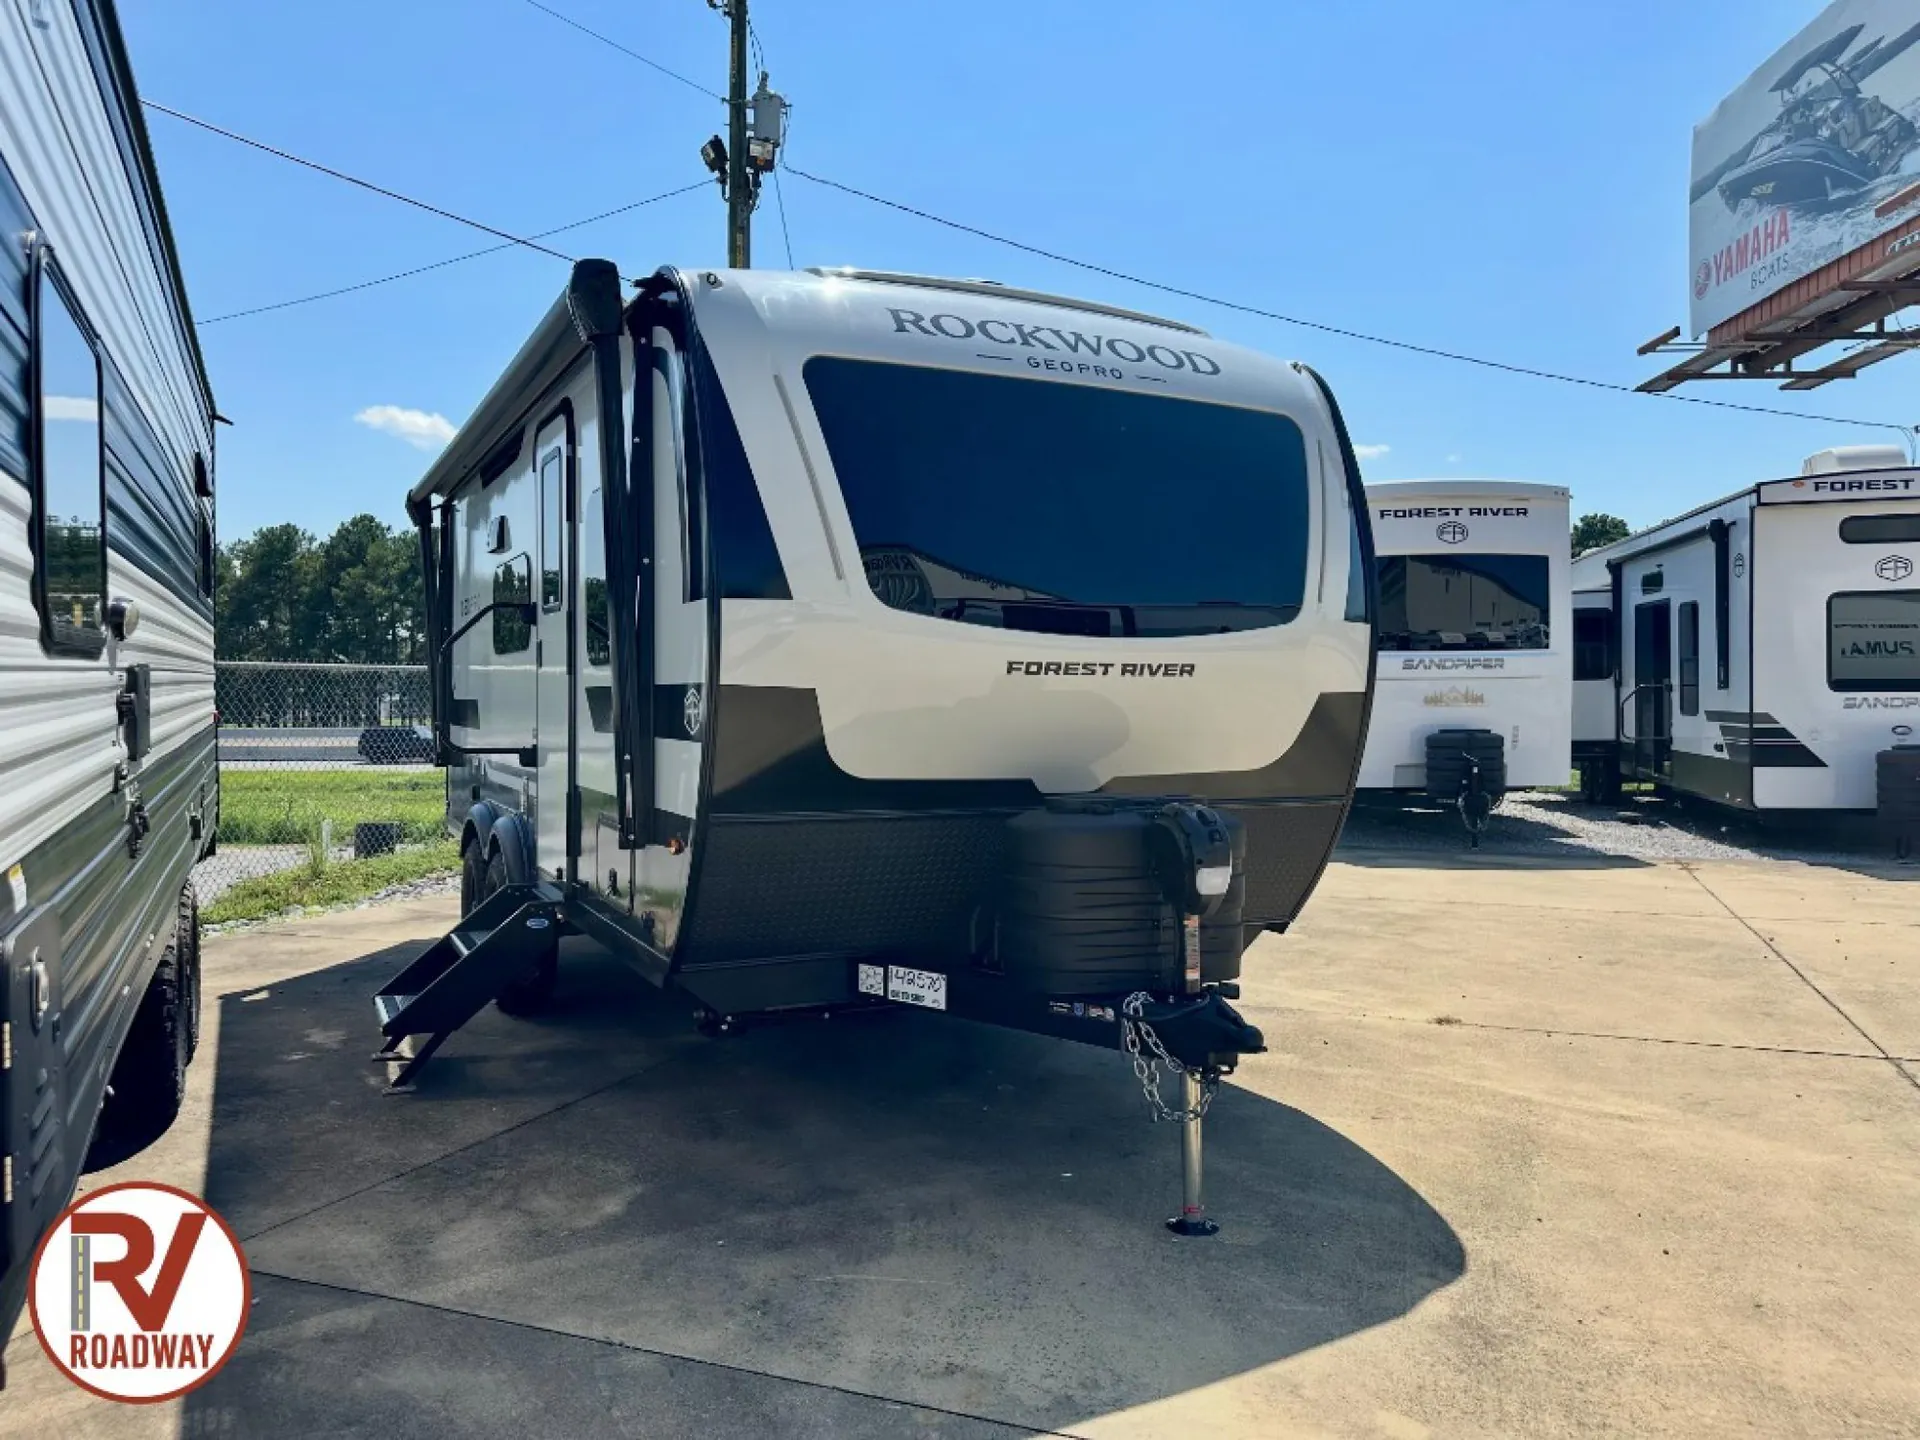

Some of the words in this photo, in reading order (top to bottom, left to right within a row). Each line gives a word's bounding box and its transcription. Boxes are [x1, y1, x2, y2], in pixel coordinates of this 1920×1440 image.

[1713, 208, 1790, 287] YAMAHA
[1750, 252, 1790, 289] BOATS
[885, 307, 1221, 375] ROCKWOOD
[1026, 355, 1123, 380] GEOPRO
[1812, 477, 1915, 493] FOREST
[1378, 507, 1464, 519] FOREST
[1468, 507, 1529, 518] RIVER
[1007, 660, 1115, 676] FOREST
[1120, 662, 1196, 677] RIVER
[1402, 657, 1505, 670] SANDPIPER
[1843, 697, 1920, 709] SANDP
